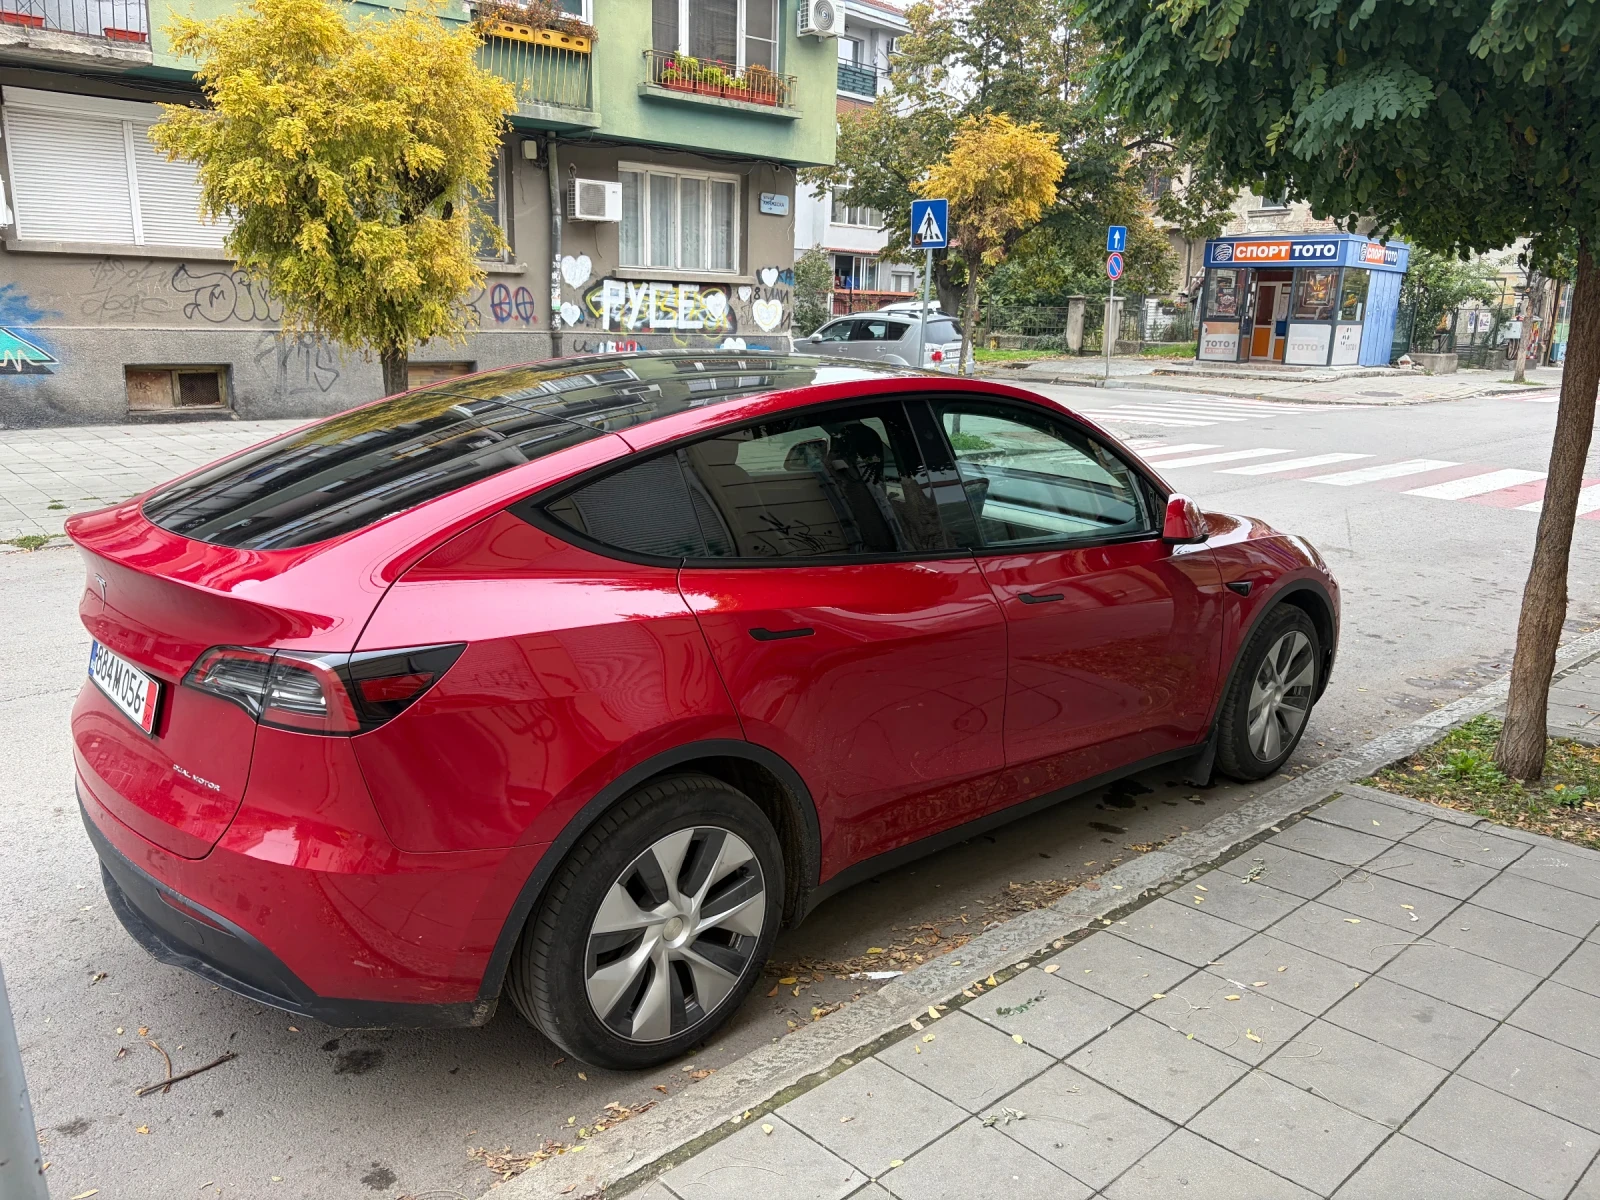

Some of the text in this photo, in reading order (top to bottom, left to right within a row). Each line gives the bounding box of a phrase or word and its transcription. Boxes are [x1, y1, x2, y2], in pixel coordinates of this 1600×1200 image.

[1236, 244, 1336, 258] СПОРТ ТОТО
[1367, 246, 1398, 262] СПОРТ ТОТО
[602, 279, 704, 330] РУСЕ
[1205, 340, 1237, 349] ТОТО 1
[1291, 343, 1318, 351] ТОТО
[192, 774, 221, 792] MOTOR
